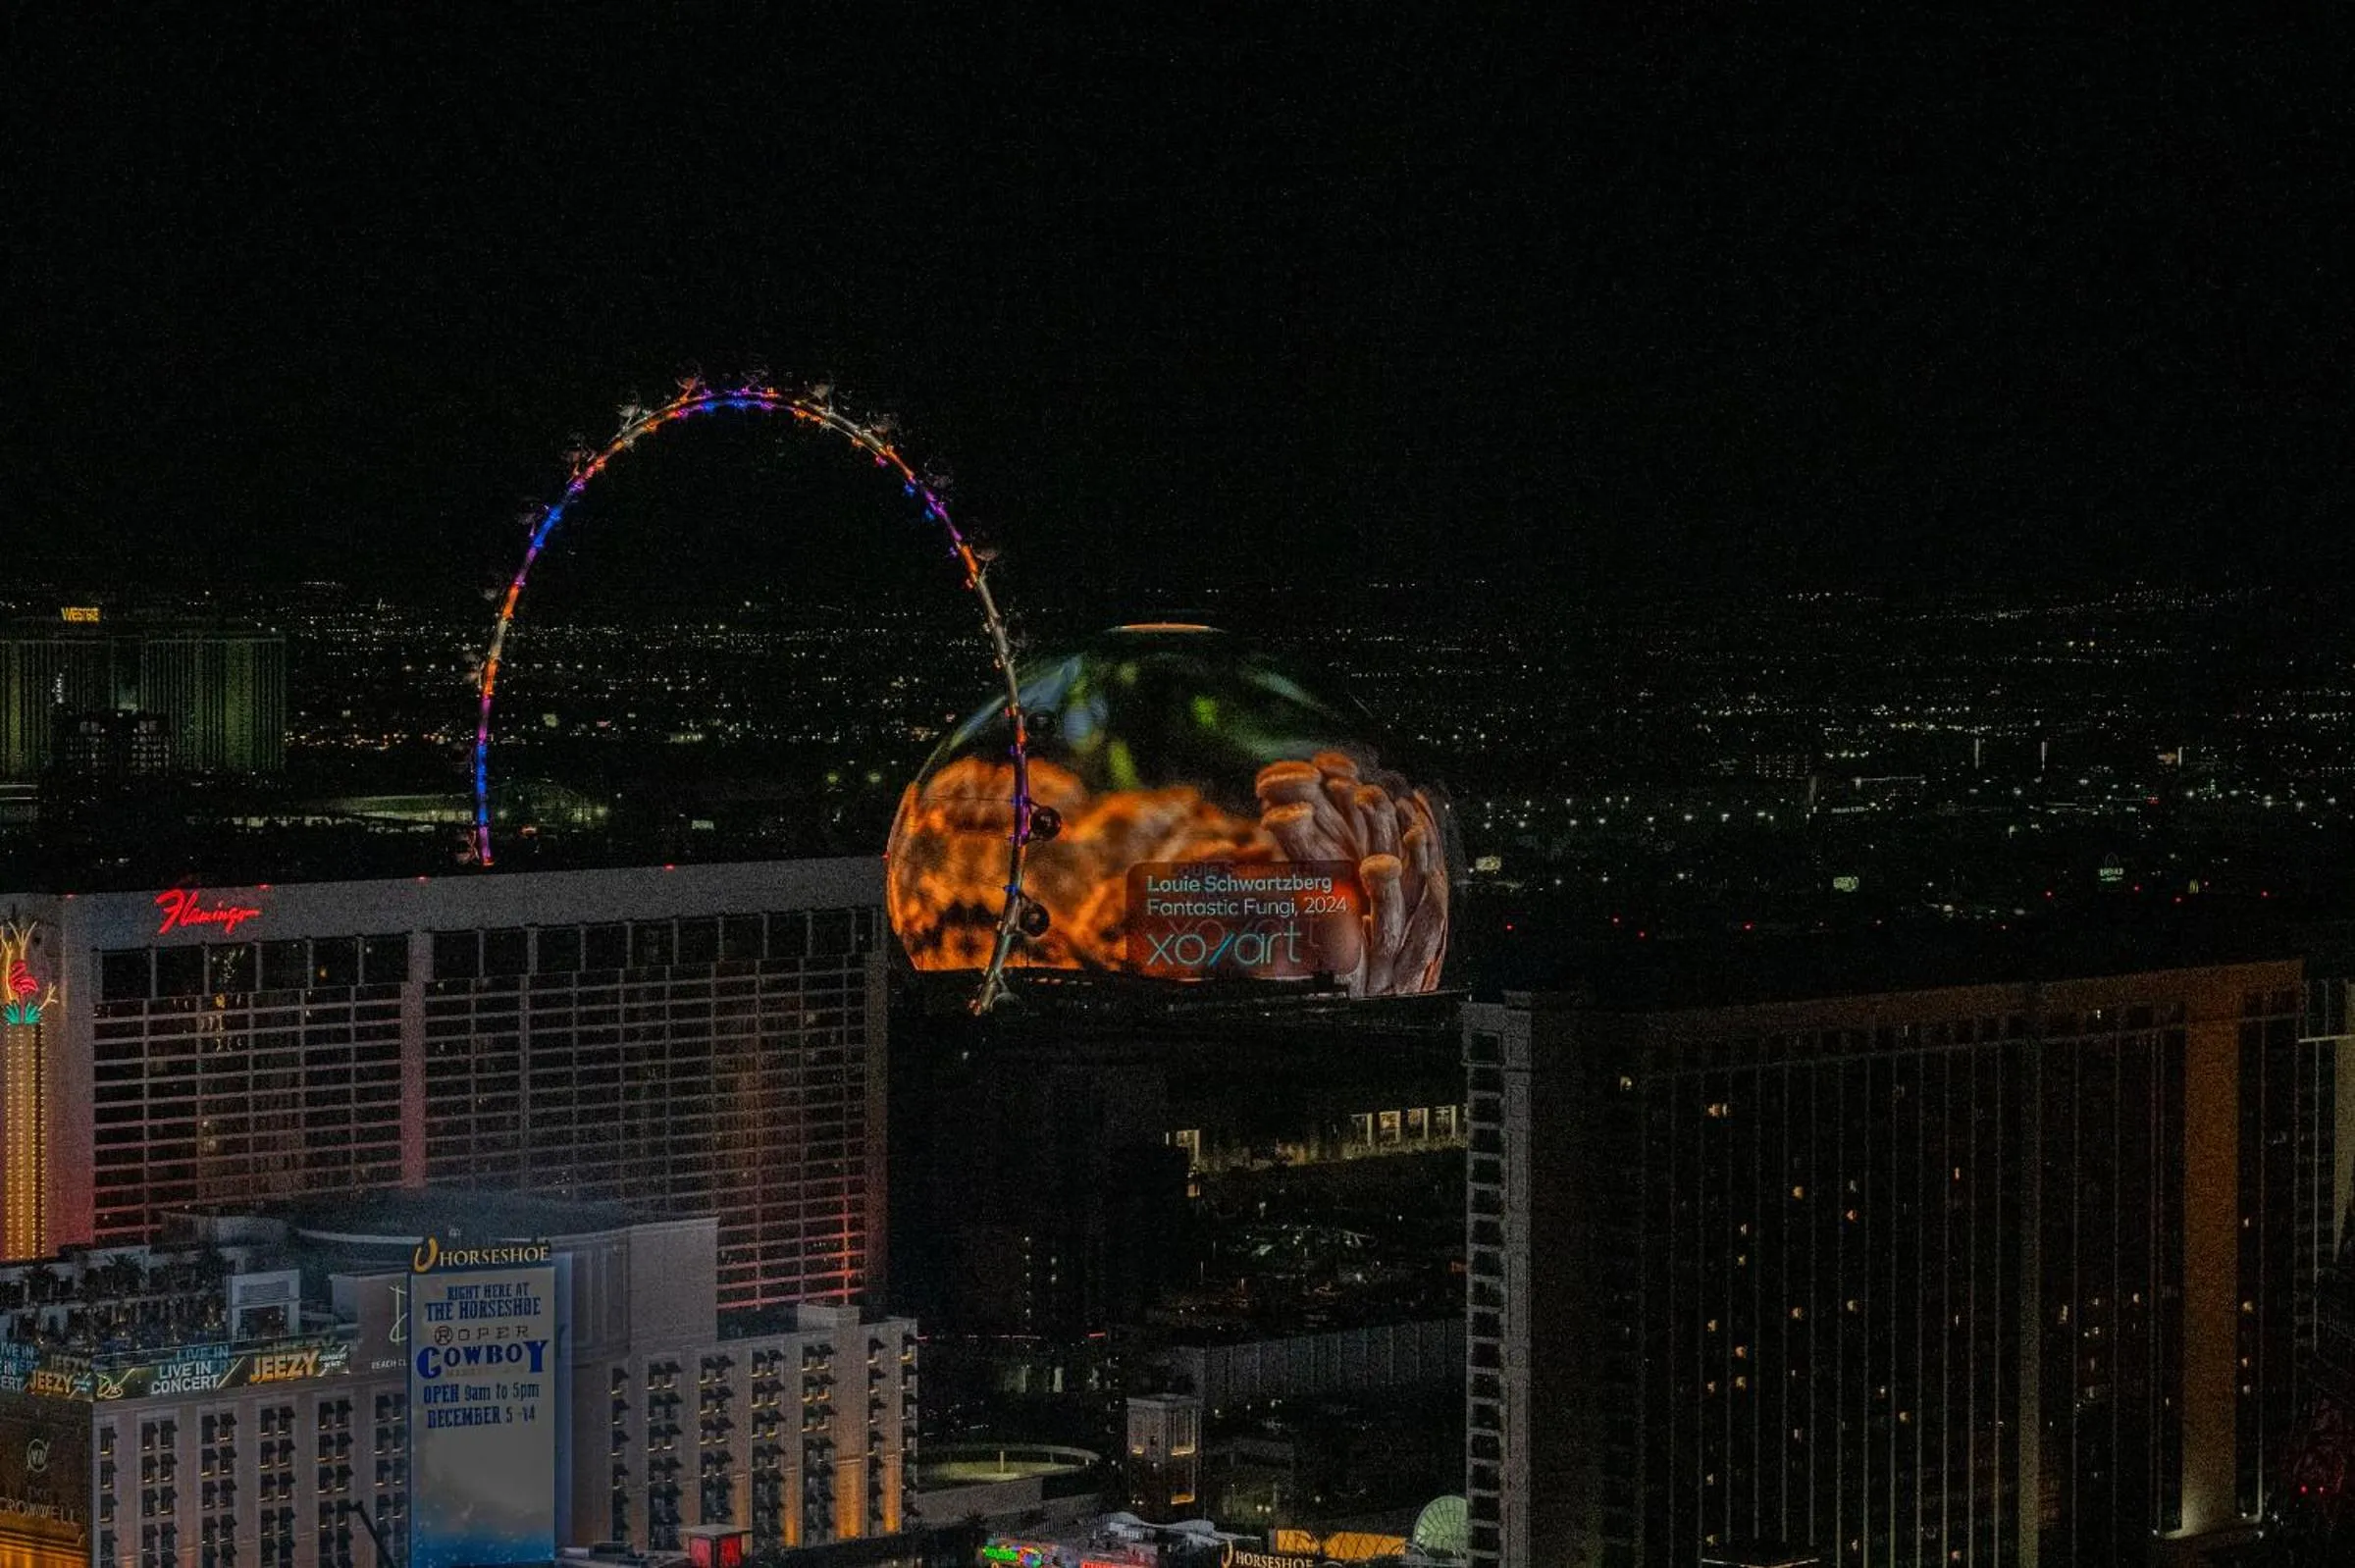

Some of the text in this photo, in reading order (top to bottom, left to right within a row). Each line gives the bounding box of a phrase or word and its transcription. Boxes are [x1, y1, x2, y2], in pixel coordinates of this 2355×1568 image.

[1147, 875, 1333, 893] Louie Schwartzberg
[155, 888, 260, 935] Flamingo
[1147, 897, 1348, 917] Fantastic Fungi, 2024
[1146, 920, 1302, 967] xo/art
[440, 1245, 551, 1267] HORSESHOE
[446, 1282, 530, 1300] RIGHT HERE AT
[425, 1297, 541, 1322] THE HORSESHOE
[160, 1361, 195, 1380] LIVE
[196, 1359, 212, 1375] IN
[249, 1349, 319, 1383] JEEZY
[416, 1339, 549, 1379] COWBOY
[28, 1370, 74, 1394] JEEZY
[151, 1374, 220, 1395] CONCERT
[423, 1382, 541, 1403] OPEN 9am to 5pm
[427, 1405, 501, 1429] DECEMBER
